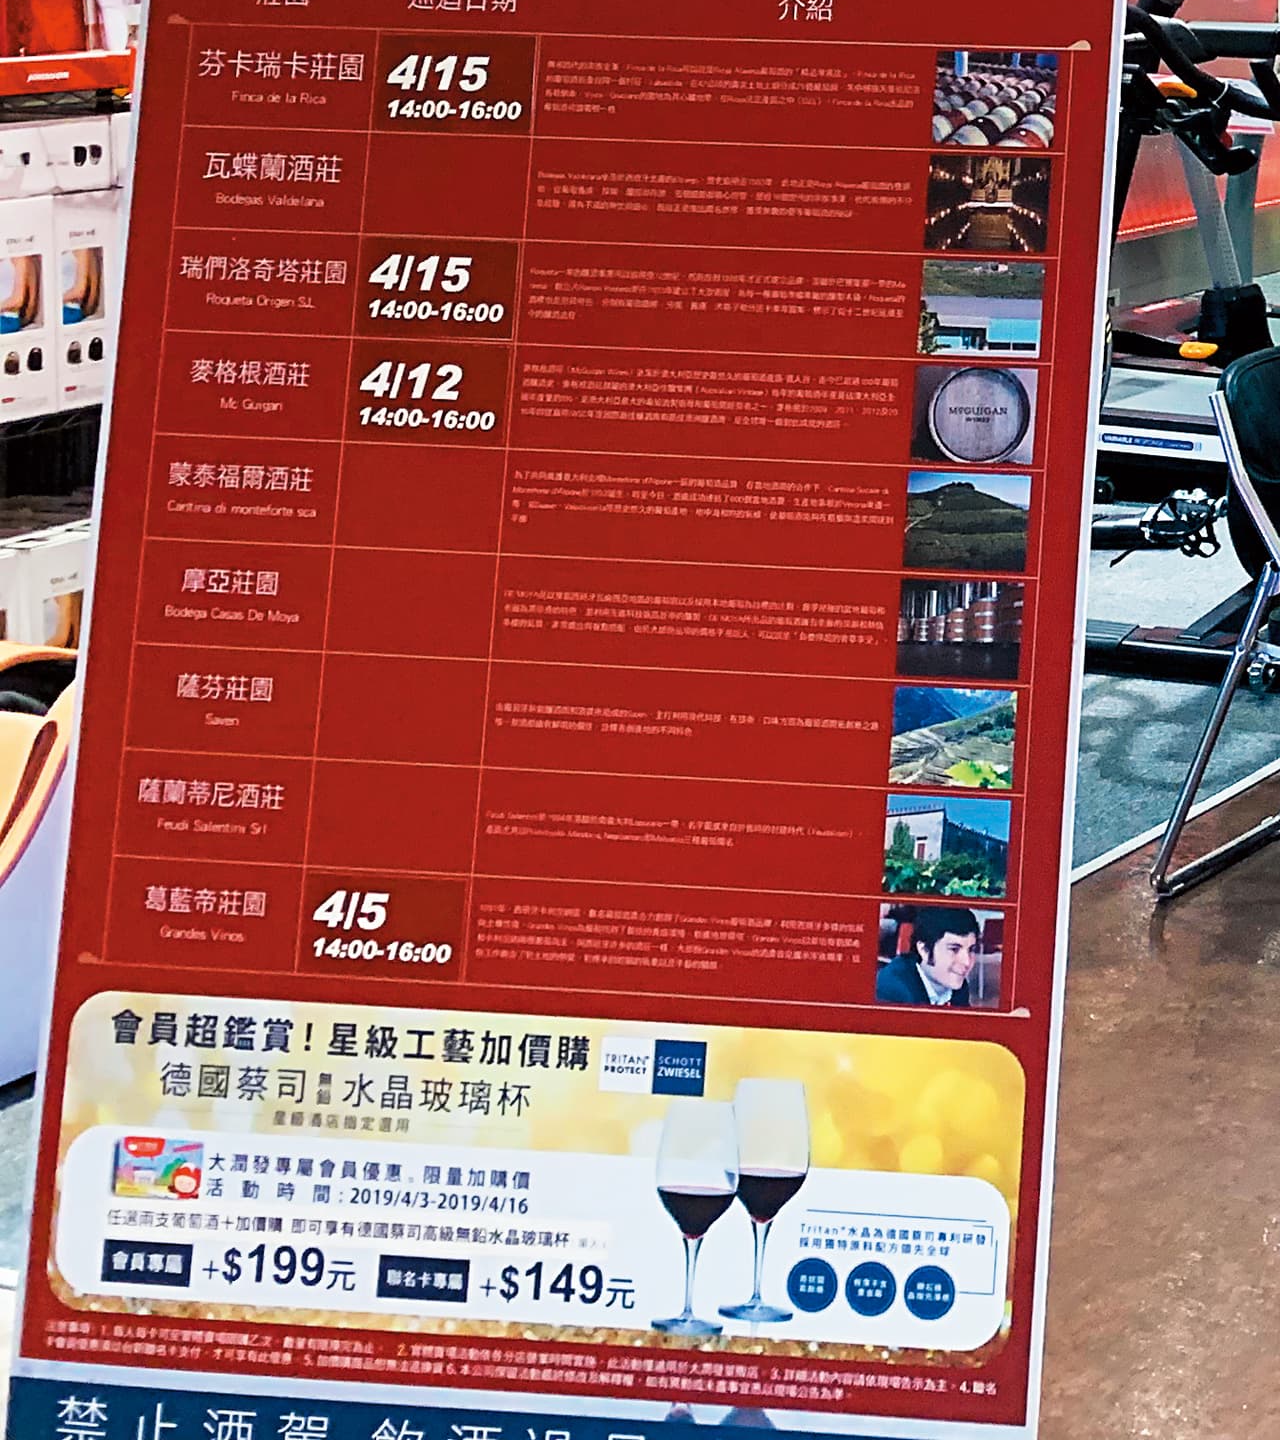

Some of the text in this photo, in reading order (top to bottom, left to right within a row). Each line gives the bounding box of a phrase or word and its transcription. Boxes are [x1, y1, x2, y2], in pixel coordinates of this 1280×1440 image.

[197, 49, 365, 82] 芬卡瑞卡莊園
[387, 54, 490, 93] 4/15
[387, 99, 522, 121] 14:00-16:00
[202, 151, 343, 184] 瓦蝶蘭酒莊
[179, 255, 348, 285] 瑞們洛奇塔莊園
[368, 253, 473, 293] 4/15
[368, 299, 504, 323] 14:00-16:00
[190, 359, 311, 388] 麥格根酒莊
[359, 361, 464, 401] 4/12
[359, 406, 495, 431] 14:00-16:00
[168, 462, 314, 492] 蒙泰福爾酒莊
[181, 568, 279, 596] 摩亞莊園
[177, 673, 274, 703] 薩芬莊園
[138, 777, 285, 810] 薩蘭蒂尼酒莊
[313, 890, 389, 931] 4/5
[312, 937, 452, 965] 14:00-16:00
[603, 1065, 647, 1075] PROTECT
[657, 1066, 702, 1079] ZWIESEL
[658, 1056, 702, 1066] SCHOTT
